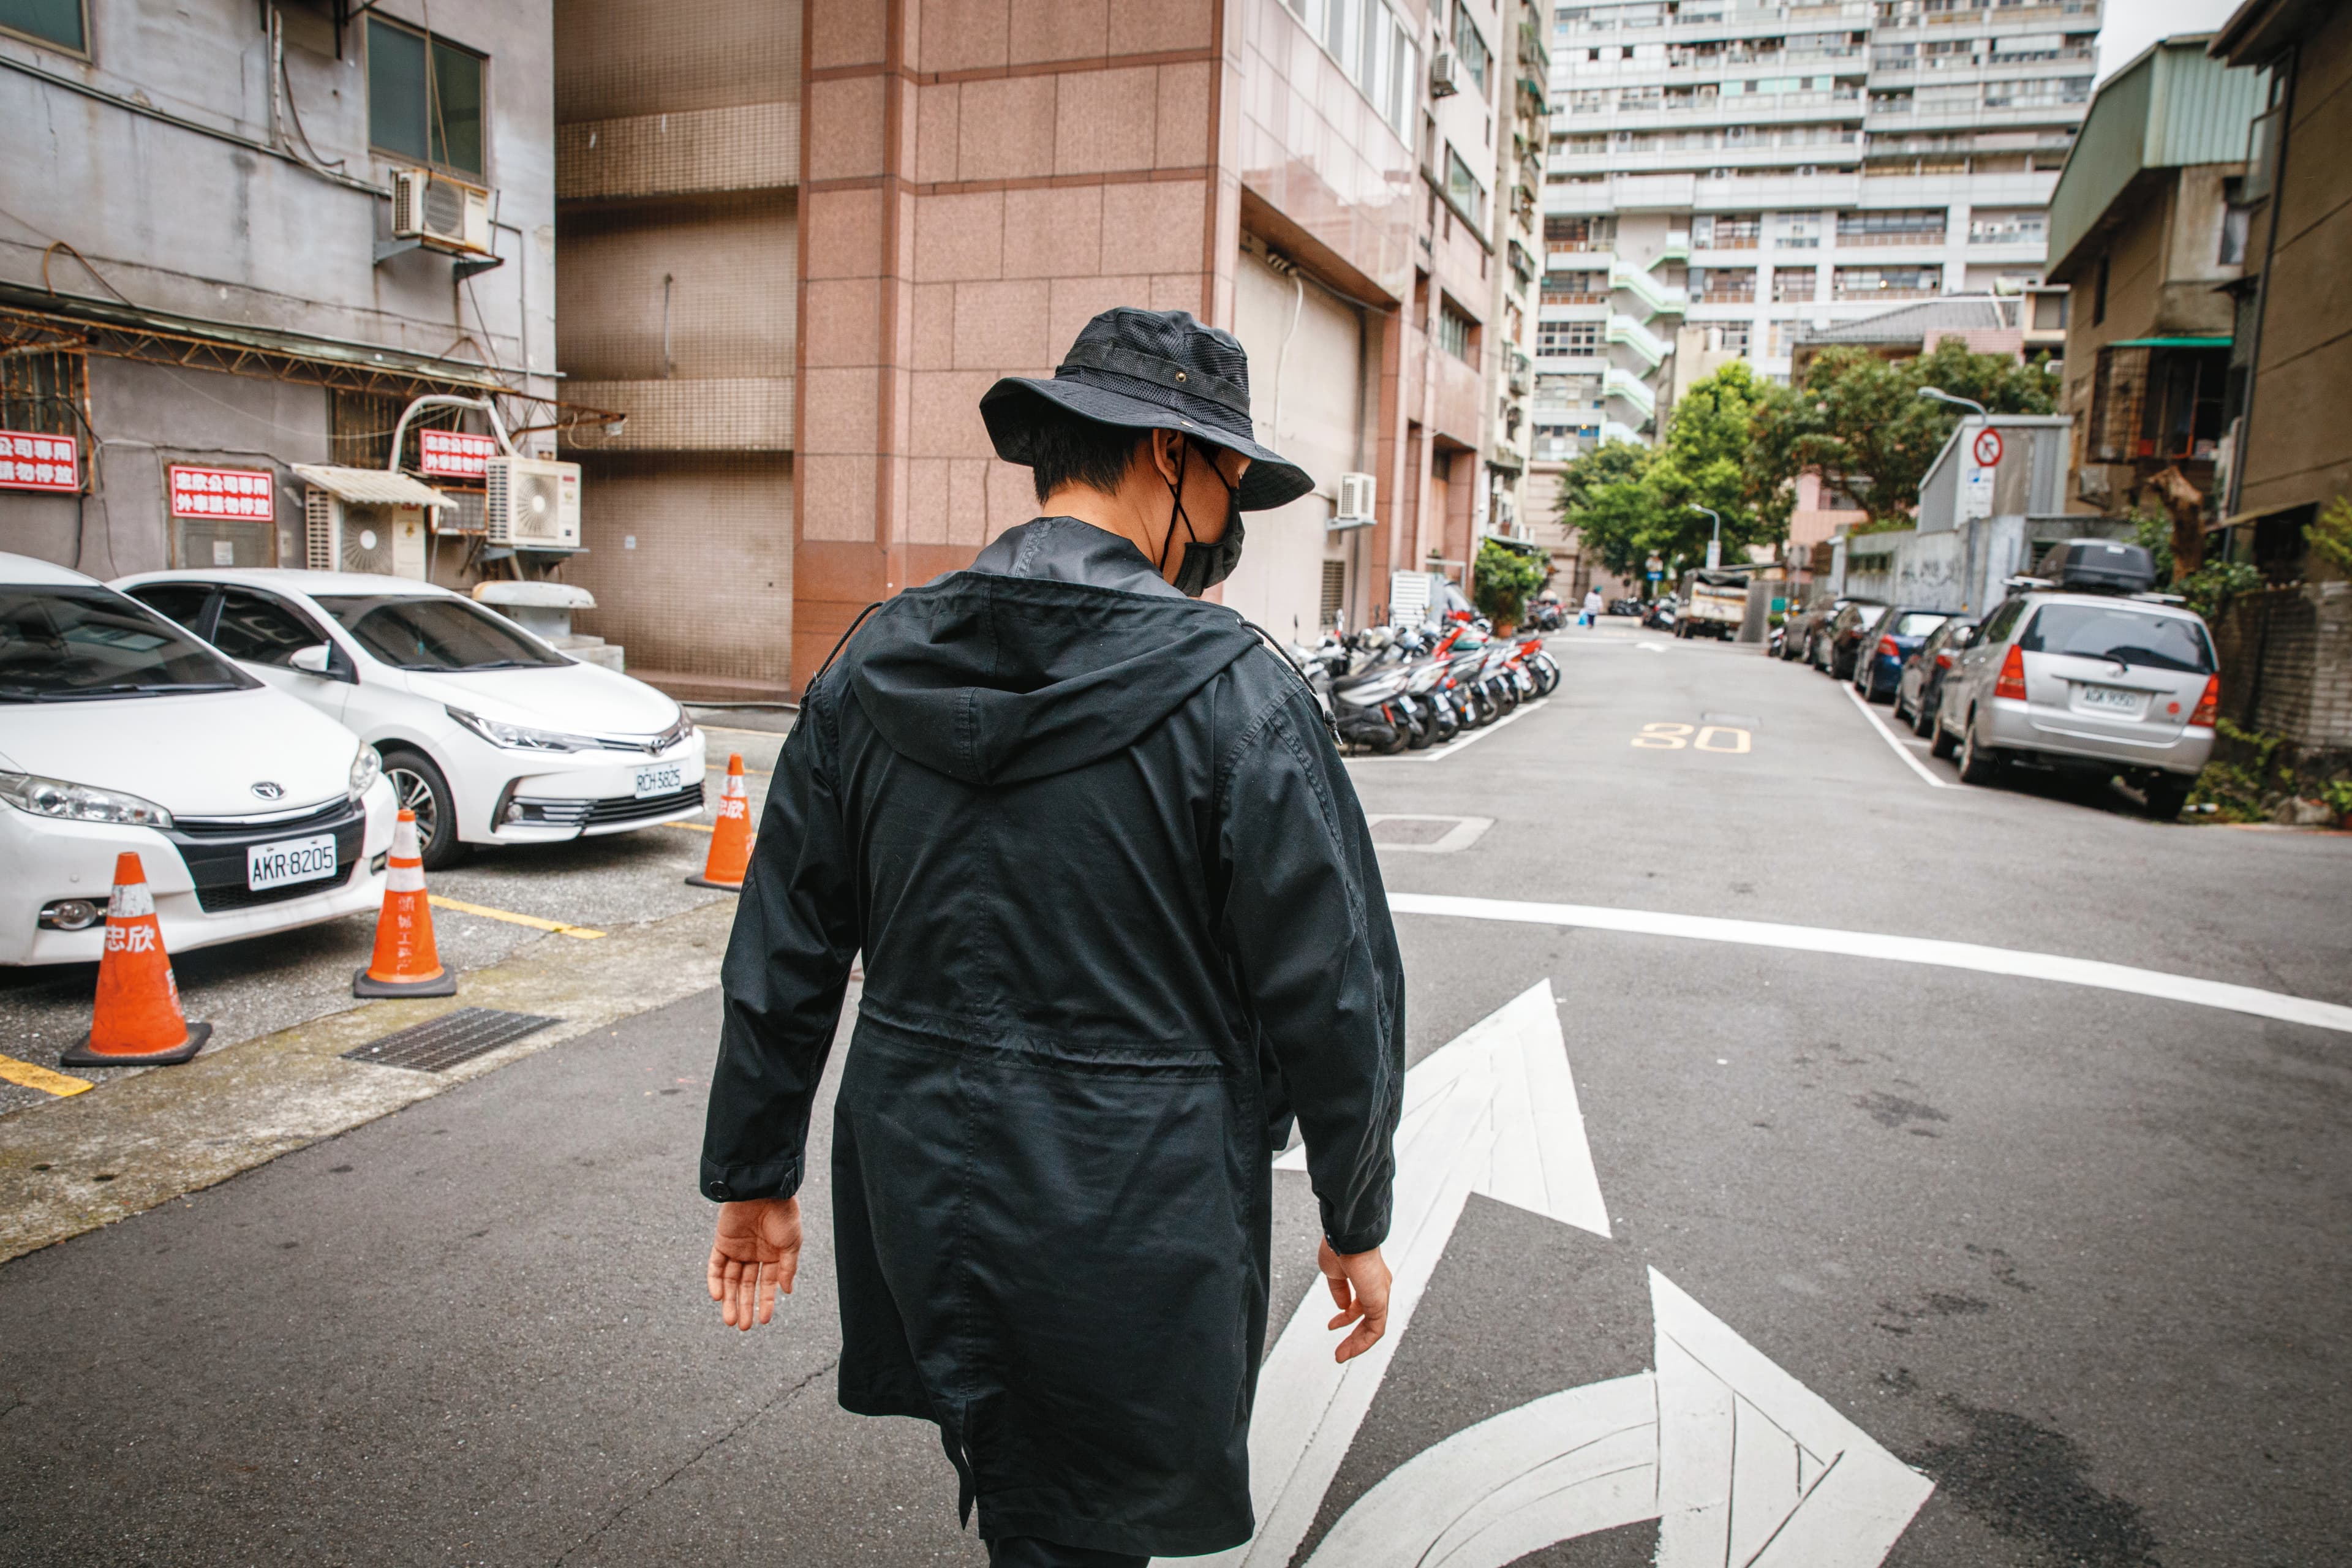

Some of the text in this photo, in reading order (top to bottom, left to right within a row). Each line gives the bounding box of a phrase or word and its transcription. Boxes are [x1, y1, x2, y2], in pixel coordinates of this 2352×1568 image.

[426, 453, 489, 473] 外車請勿停
[176, 492, 269, 516] 外車請勿停放
[1630, 722, 1751, 754] 30
[253, 846, 333, 882] AKR-8205
[105, 924, 155, 952] 忠欣
